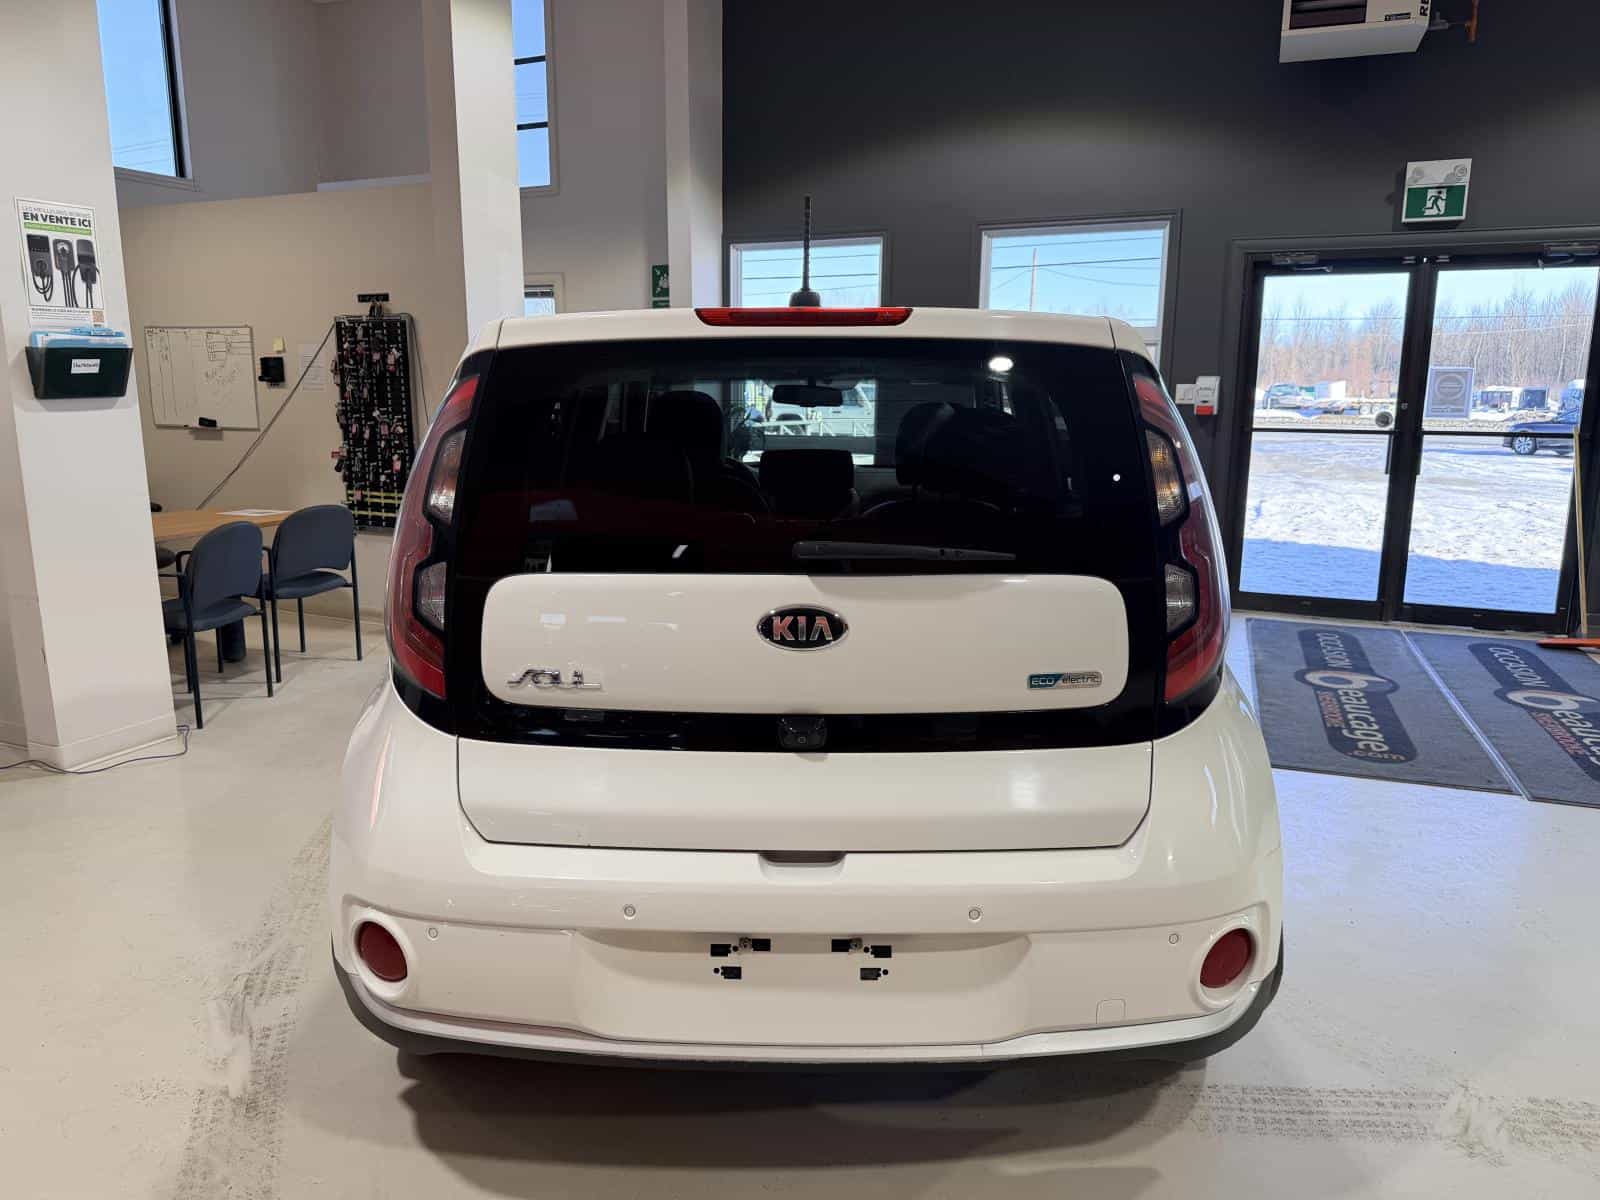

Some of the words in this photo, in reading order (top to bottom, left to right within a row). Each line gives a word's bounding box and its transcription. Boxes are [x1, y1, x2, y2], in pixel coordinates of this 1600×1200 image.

[23, 212, 39, 222] EN
[40, 213, 77, 226] VENTE
[78, 218, 92, 228] ICI
[772, 615, 833, 641] KIA
[1487, 647, 1551, 688] OCCASION
